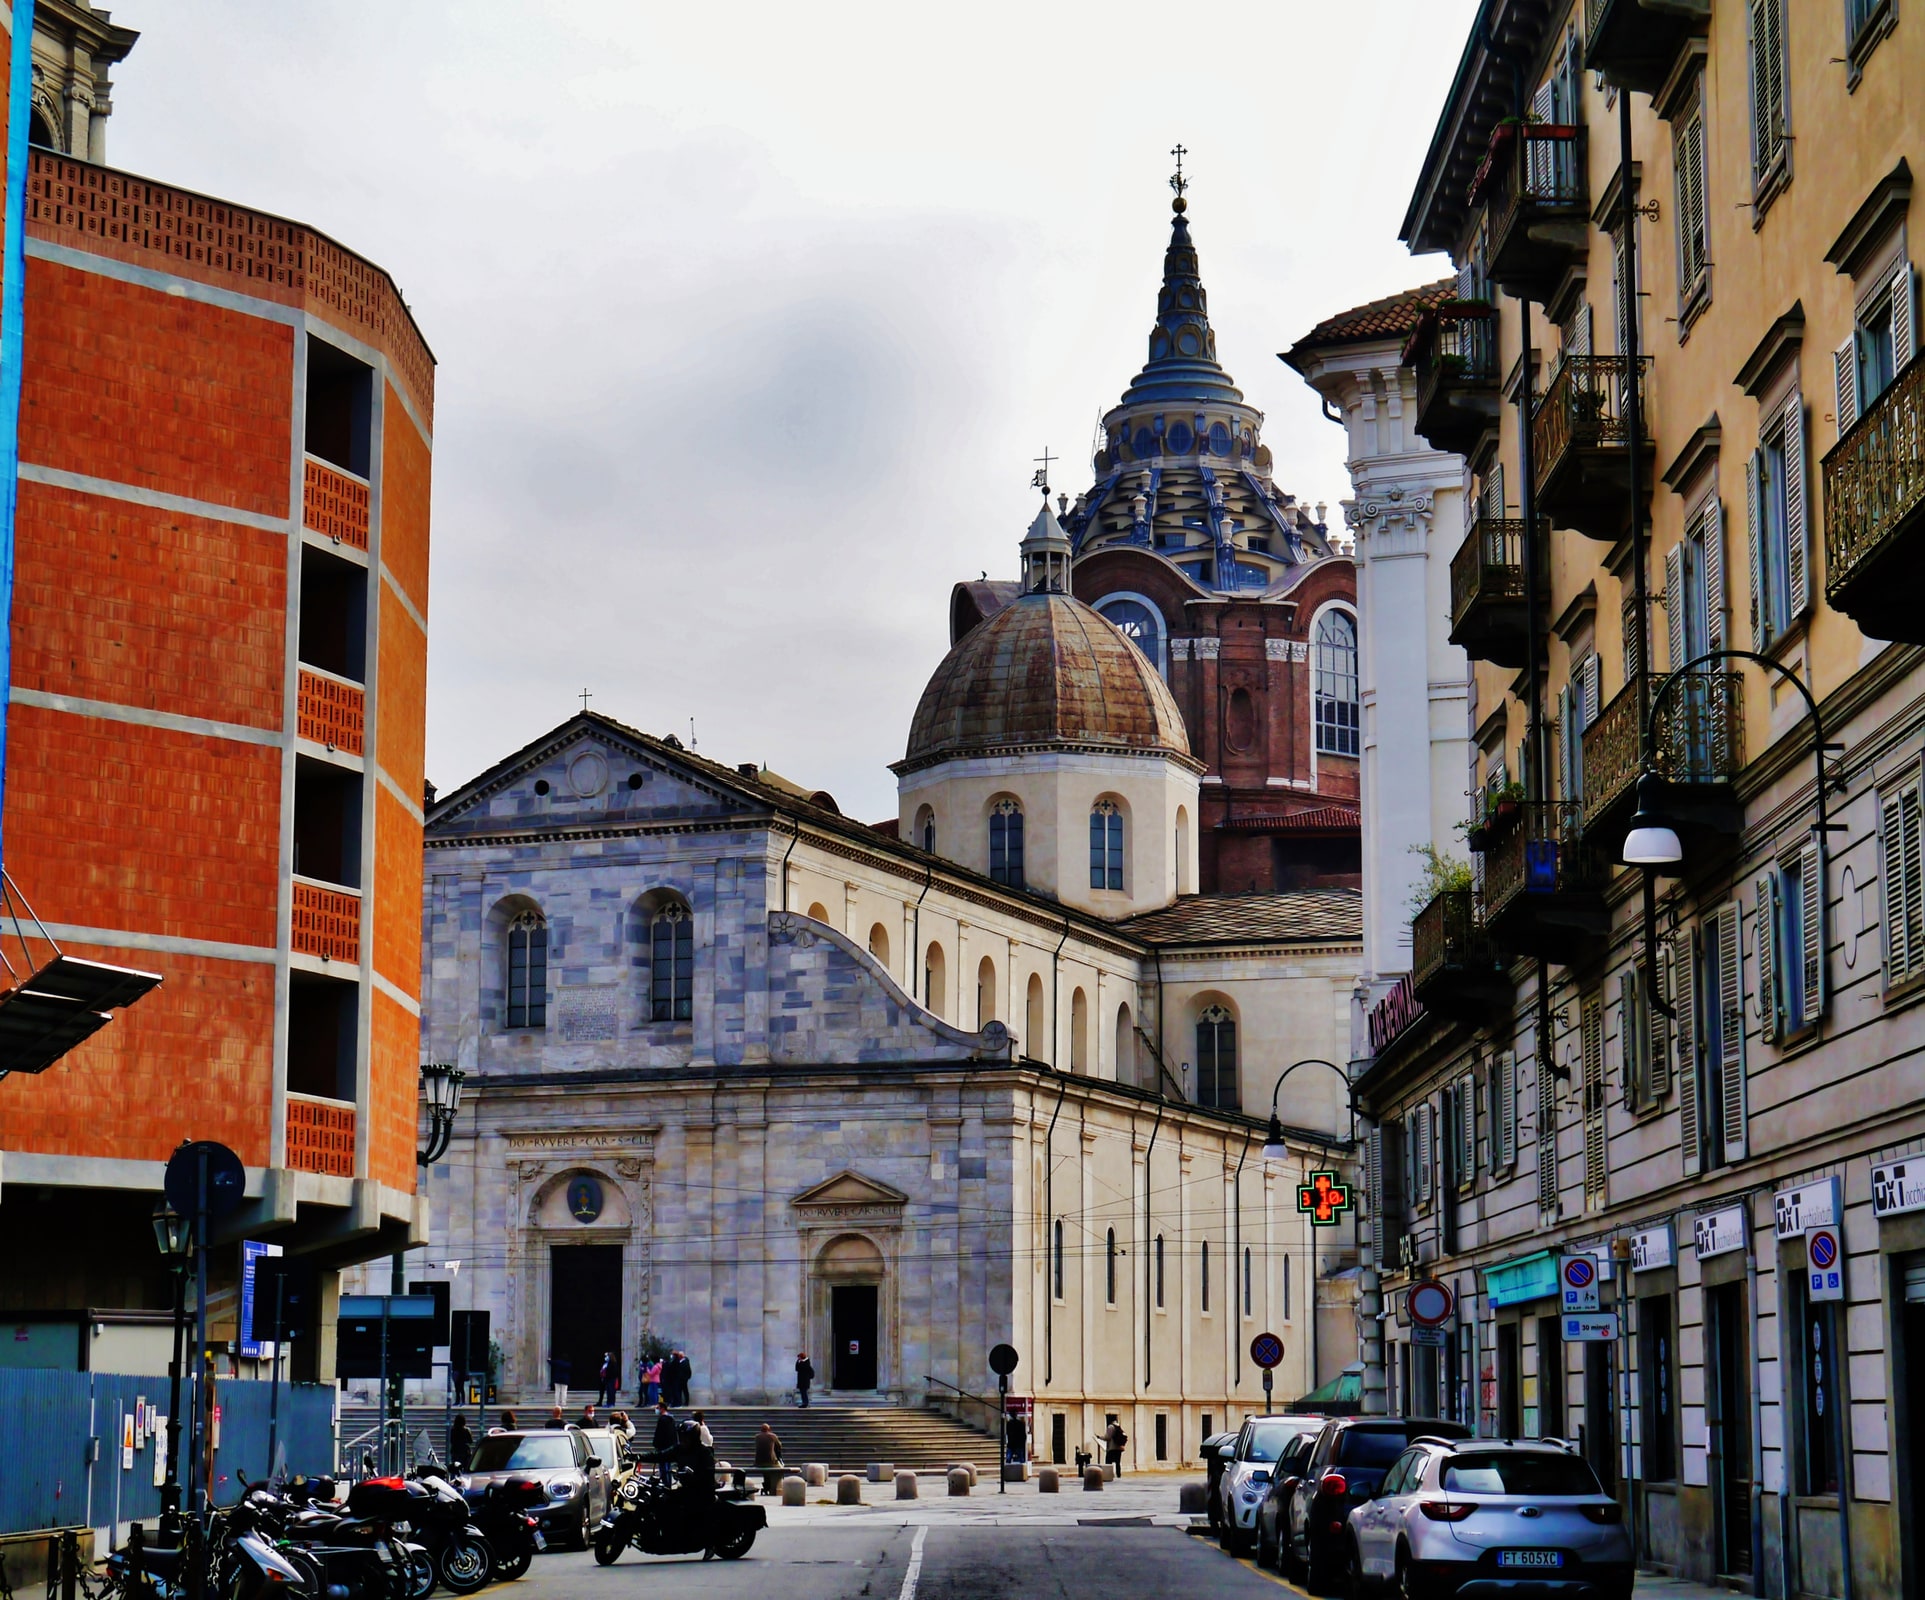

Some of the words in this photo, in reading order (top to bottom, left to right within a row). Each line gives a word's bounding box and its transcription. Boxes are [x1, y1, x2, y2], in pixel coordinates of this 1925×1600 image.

[534, 1138, 577, 1147] RVVERE
[585, 1137, 609, 1146] CAR
[617, 1136, 624, 1145] S
[1591, 1323, 1611, 1331] minuti
[1503, 1552, 1517, 1564] FT
[1520, 1552, 1556, 1565] 605XC
